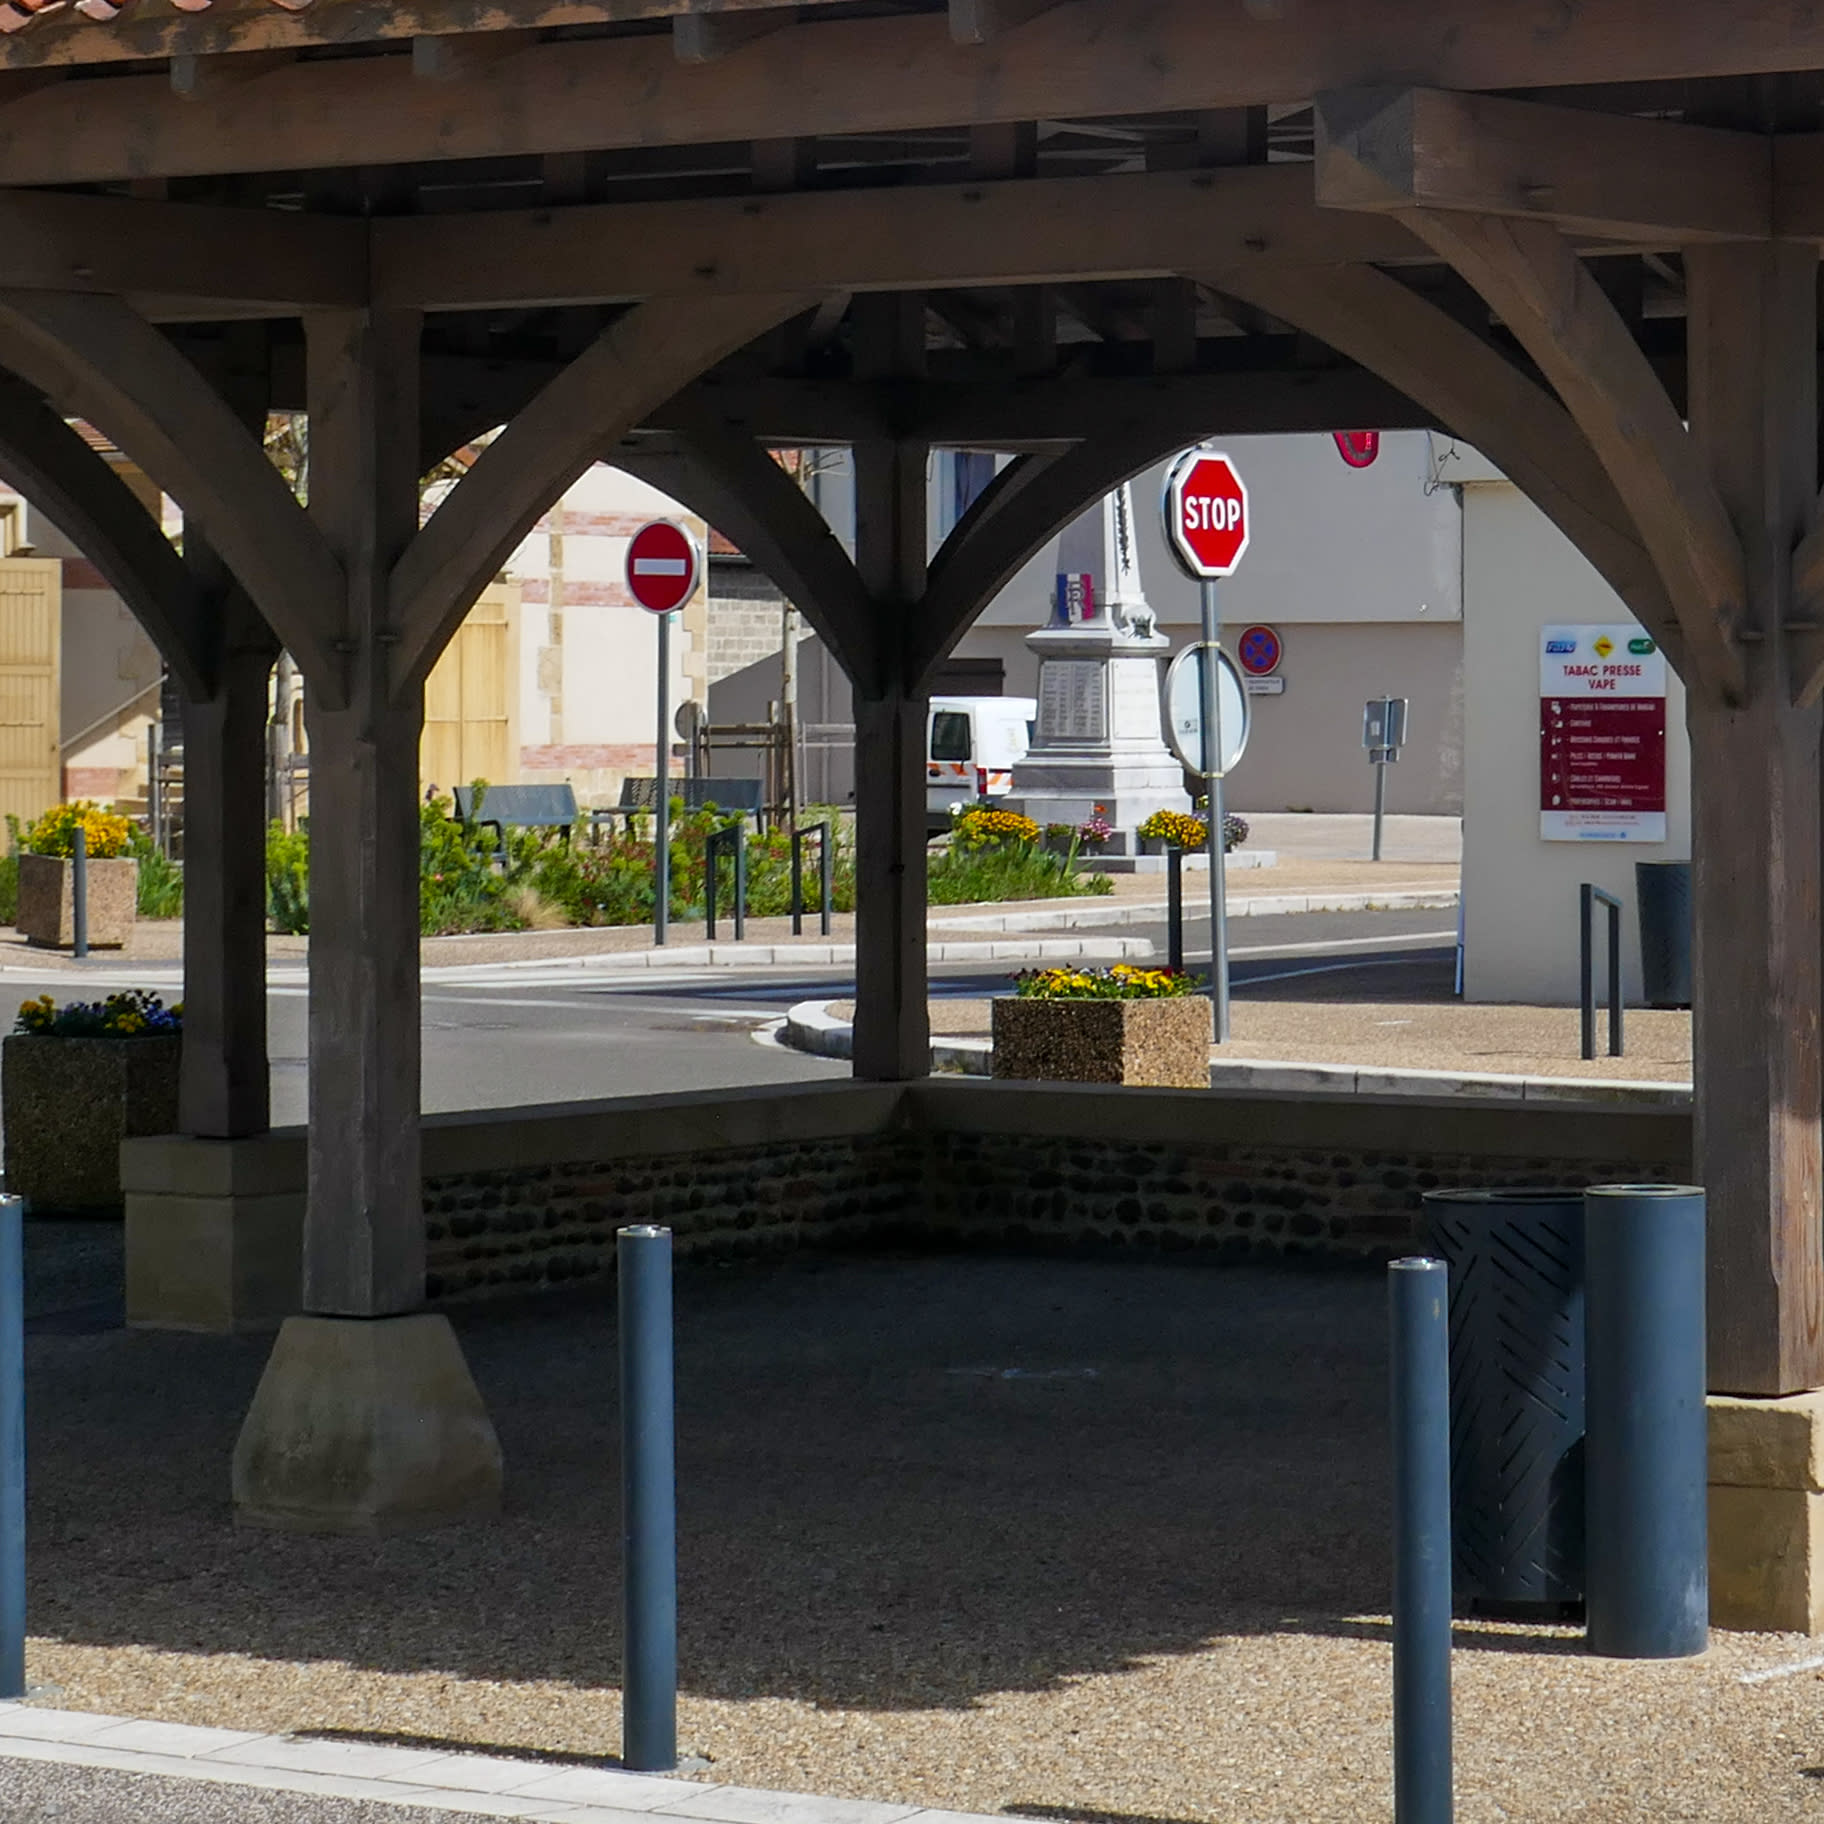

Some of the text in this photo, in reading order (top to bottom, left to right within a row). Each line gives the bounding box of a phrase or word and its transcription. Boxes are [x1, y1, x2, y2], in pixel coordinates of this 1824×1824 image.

[1185, 495, 1241, 532] STOP
[1563, 664, 1642, 677] TABAC PRESSE
[1588, 679, 1616, 690] VAPE
